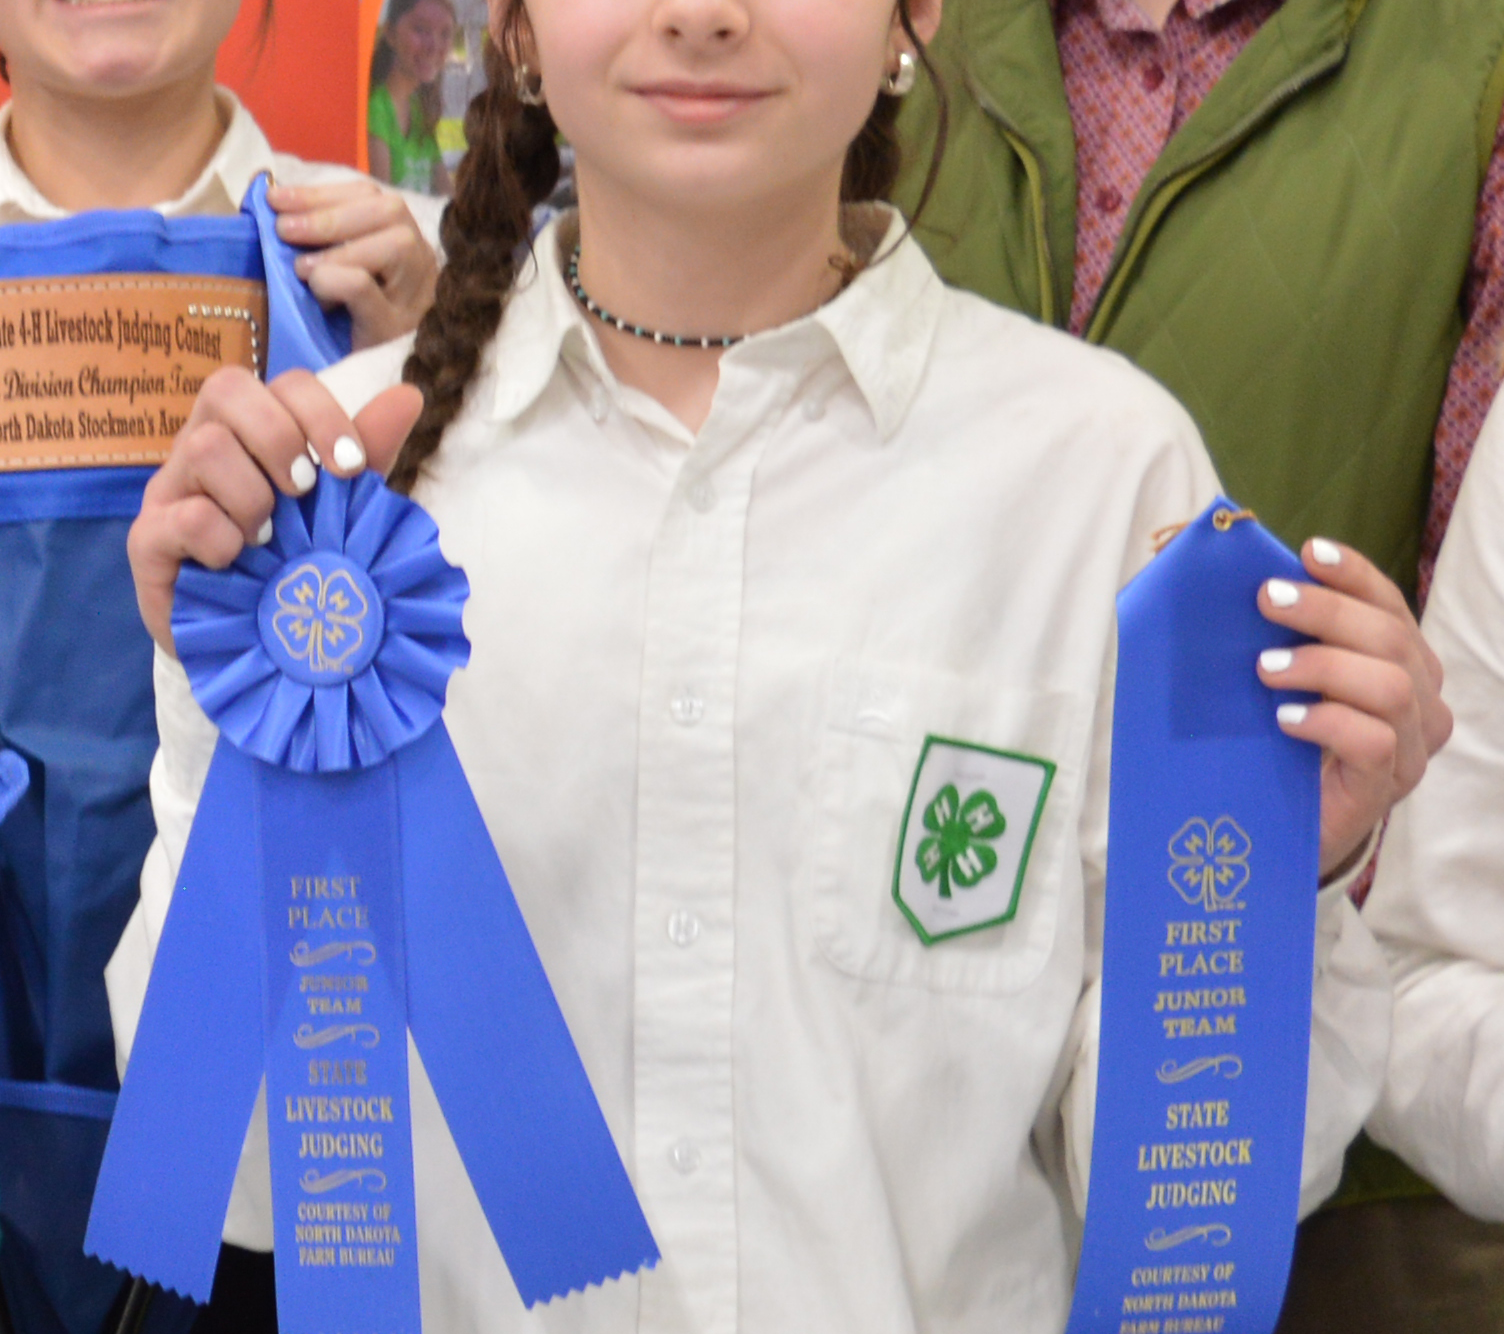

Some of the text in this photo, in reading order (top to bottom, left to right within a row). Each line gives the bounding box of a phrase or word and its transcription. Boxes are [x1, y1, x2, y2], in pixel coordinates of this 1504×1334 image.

[18, 309, 42, 348] 4-H
[45, 310, 114, 347] Livestock
[116, 309, 172, 358] Judging
[174, 315, 223, 363] Contest
[2, 368, 74, 403] Division
[77, 365, 165, 405] Champion
[25, 412, 75, 443] Dakota
[77, 410, 156, 442] Stockmen's
[291, 875, 362, 899] FIRST
[288, 906, 370, 930] PLACE
[1166, 919, 1242, 946] FIRST
[1159, 950, 1245, 978] PLACE
[299, 974, 369, 993] JUNIOR
[307, 996, 363, 1015] TEAM
[1153, 986, 1247, 1013] JUNIOR
[1163, 1013, 1237, 1039] TEAM
[308, 1059, 367, 1086] STATE
[285, 1095, 394, 1123] LIVESTOCK
[1165, 1099, 1230, 1131] STATE
[299, 1132, 384, 1159] JUDGING
[1137, 1138, 1253, 1172] LIVESTOCK
[1145, 1178, 1237, 1211] JUDGING
[297, 1201, 392, 1222] COURTESY OF
[295, 1224, 402, 1245] NORTH DAKOTA
[299, 1246, 395, 1267] FARM BUREAU
[1131, 1261, 1236, 1288] COURTESY OF
[1122, 1288, 1237, 1315] NORTH DAKOTA
